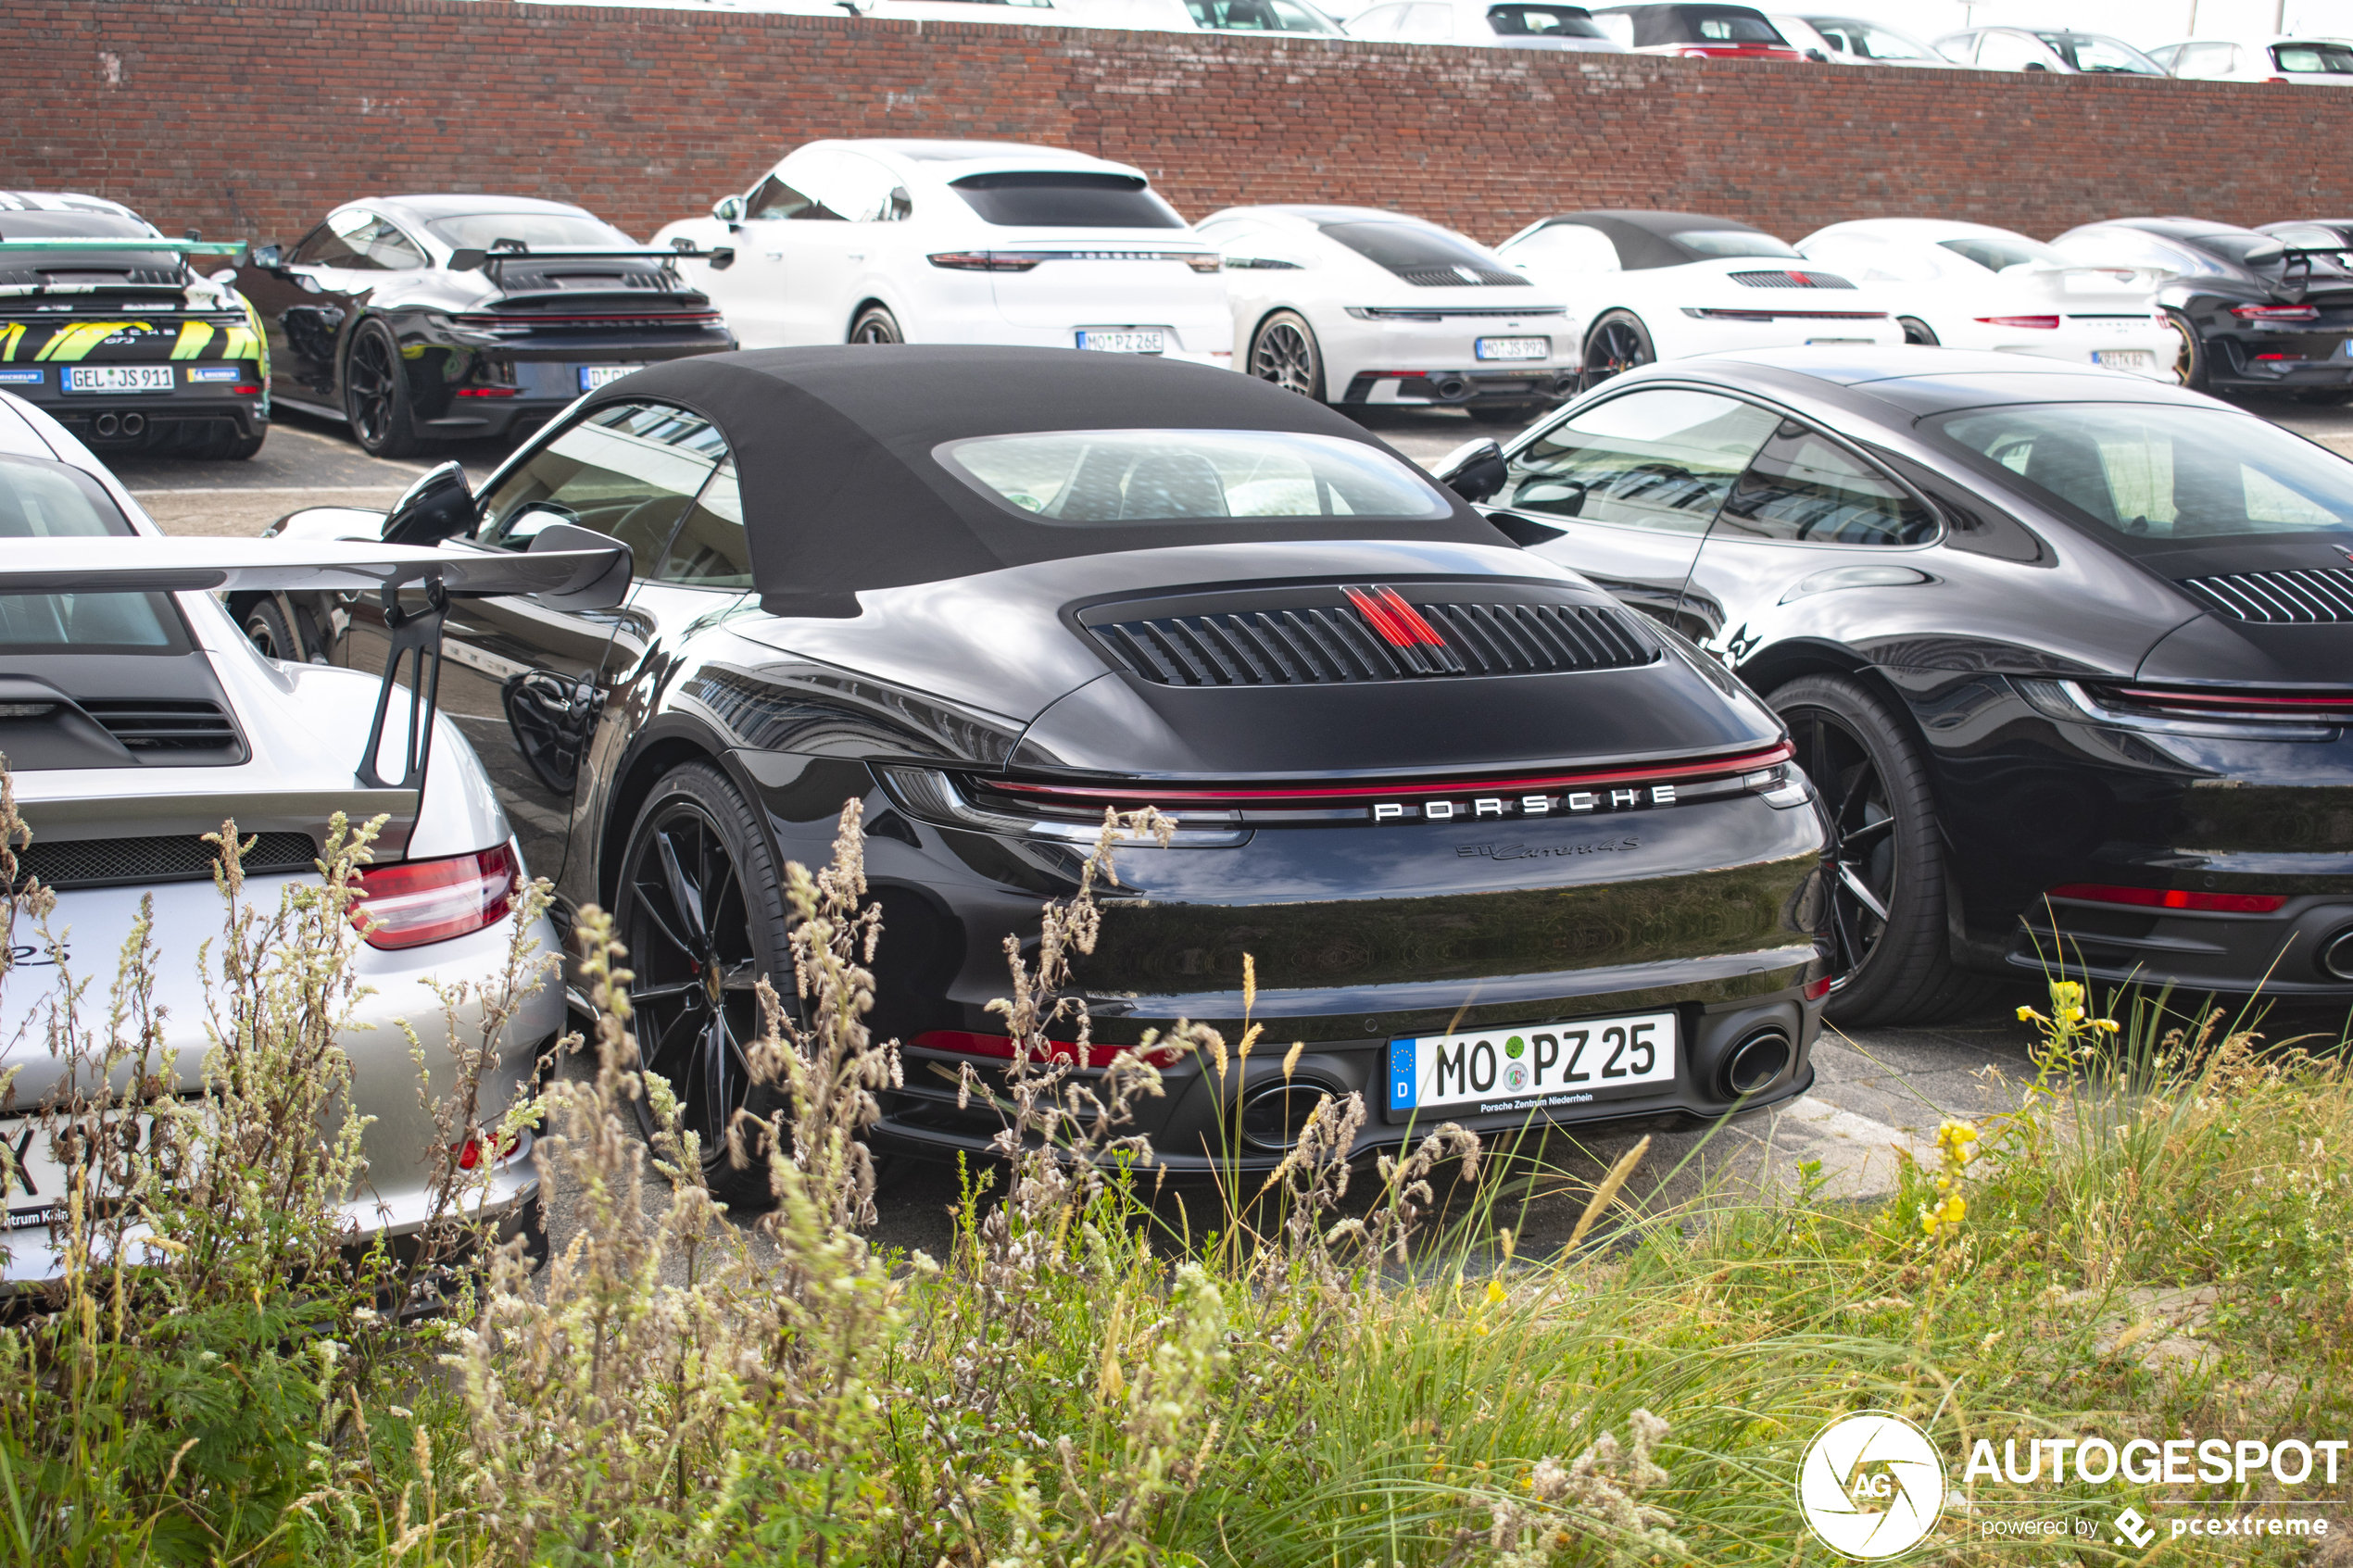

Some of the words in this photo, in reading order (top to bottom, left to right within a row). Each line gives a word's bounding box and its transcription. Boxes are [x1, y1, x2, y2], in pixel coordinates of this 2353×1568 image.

[1088, 334, 1105, 350] MO
[1115, 334, 1133, 349] PZ
[1136, 334, 1161, 348] 26E
[1483, 342, 1499, 356] MO
[1506, 342, 1521, 356] JS
[1523, 342, 1544, 355] 992
[74, 370, 105, 387] GEL
[119, 370, 137, 386] JS
[143, 370, 172, 386] 911
[592, 370, 600, 385] D
[1374, 785, 1676, 822] PORSCHE
[1455, 844, 1498, 858] 911
[1492, 842, 1593, 860] Carrera
[1597, 836, 1642, 851] 4S
[1397, 1082, 1408, 1098] D
[1437, 1039, 1496, 1097] MO
[1531, 1030, 1590, 1086] PZ
[1602, 1022, 1655, 1079] 25
[1480, 1102, 1513, 1112] Porsche
[1515, 1099, 1547, 1110] Zentrum
[1549, 1093, 1592, 1105] Niederrhein
